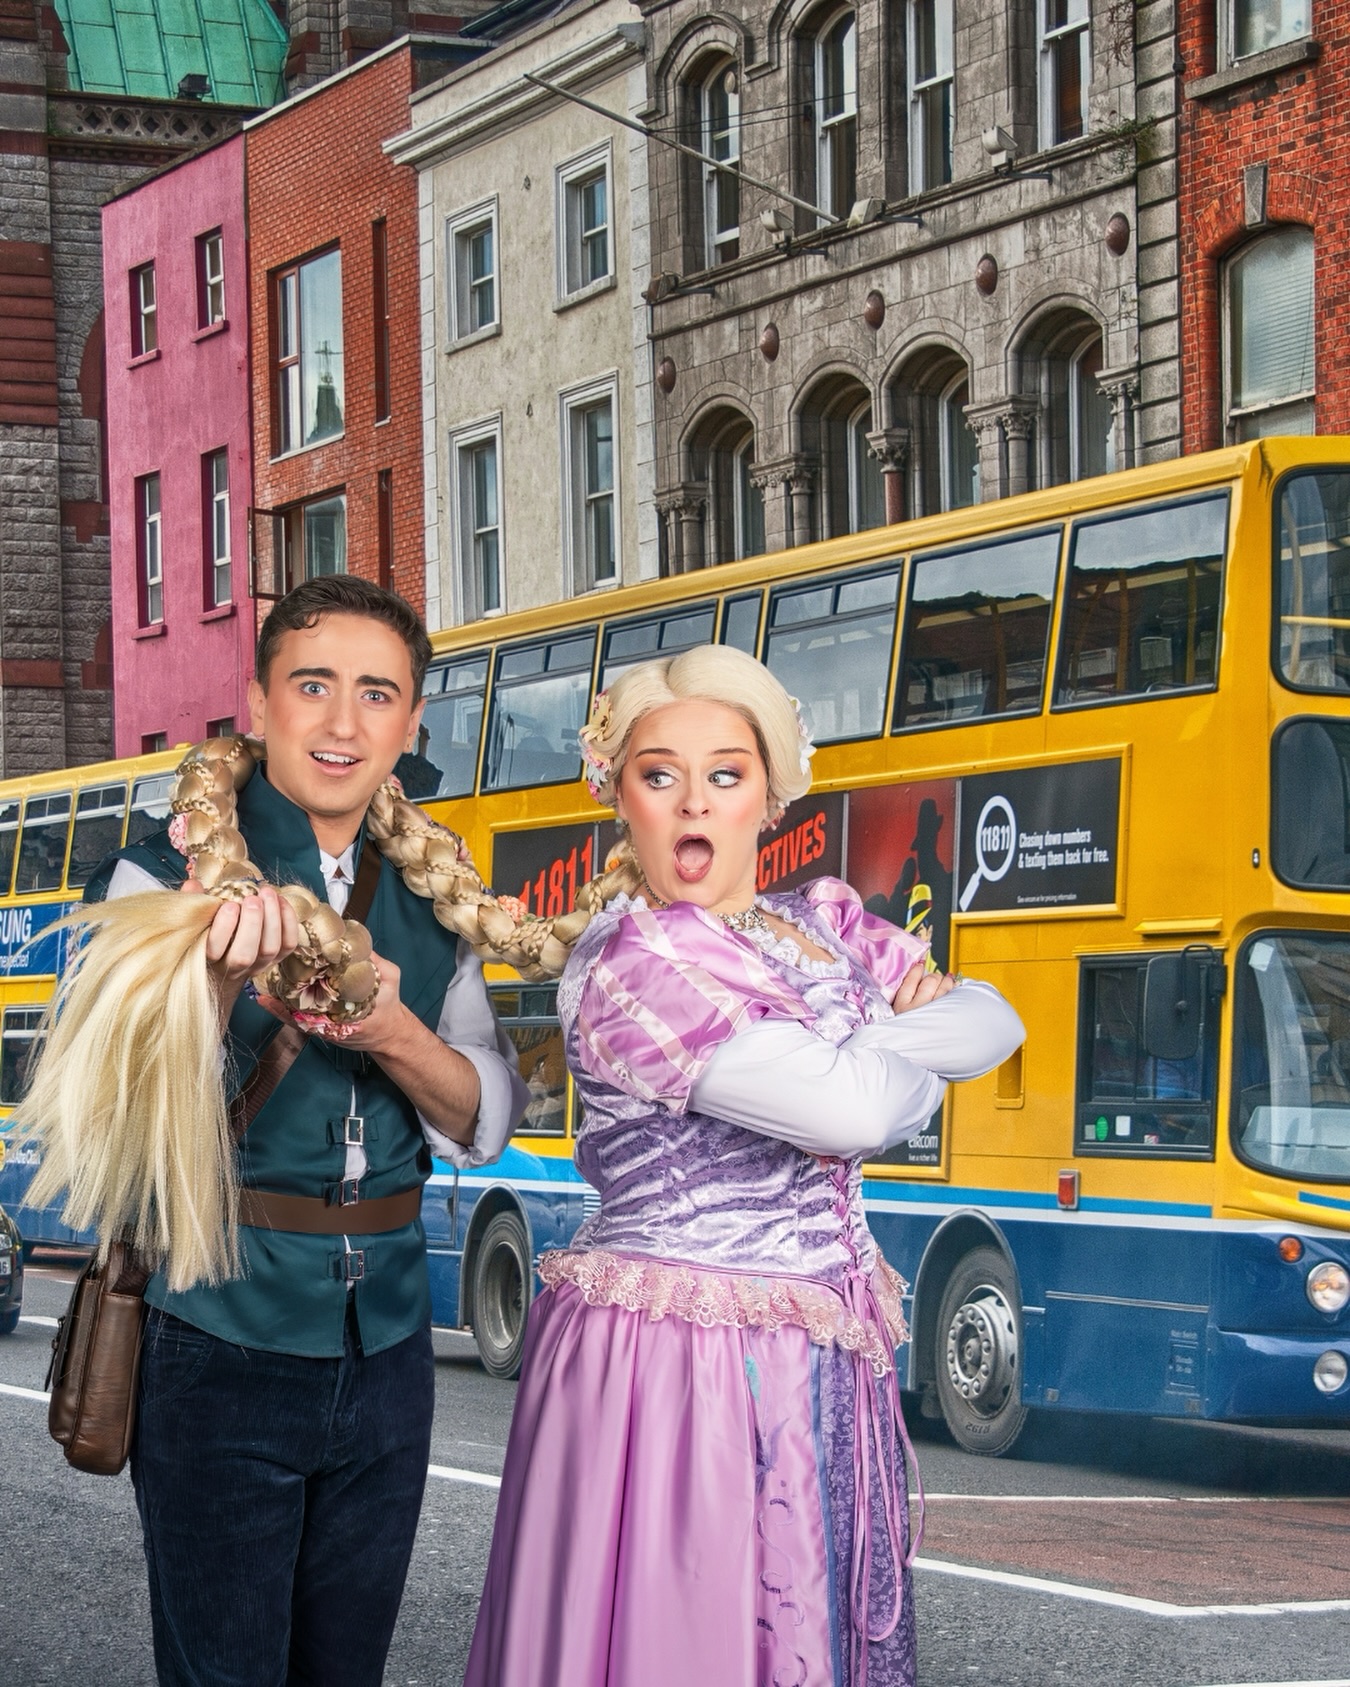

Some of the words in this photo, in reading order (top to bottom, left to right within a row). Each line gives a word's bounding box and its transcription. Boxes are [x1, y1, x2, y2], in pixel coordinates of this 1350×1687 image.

[981, 825, 1010, 852] 11811
[1019, 832, 1043, 850] Chasing
[1044, 830, 1061, 846] down
[1062, 827, 1091, 844] numbers
[755, 812, 826, 893] CTIVES
[1018, 852, 1024, 868] &
[1025, 851, 1046, 870] texting
[1047, 850, 1064, 866] them
[1065, 848, 1081, 865] back
[1082, 847, 1092, 863] for
[1093, 846, 1109, 863] free.
